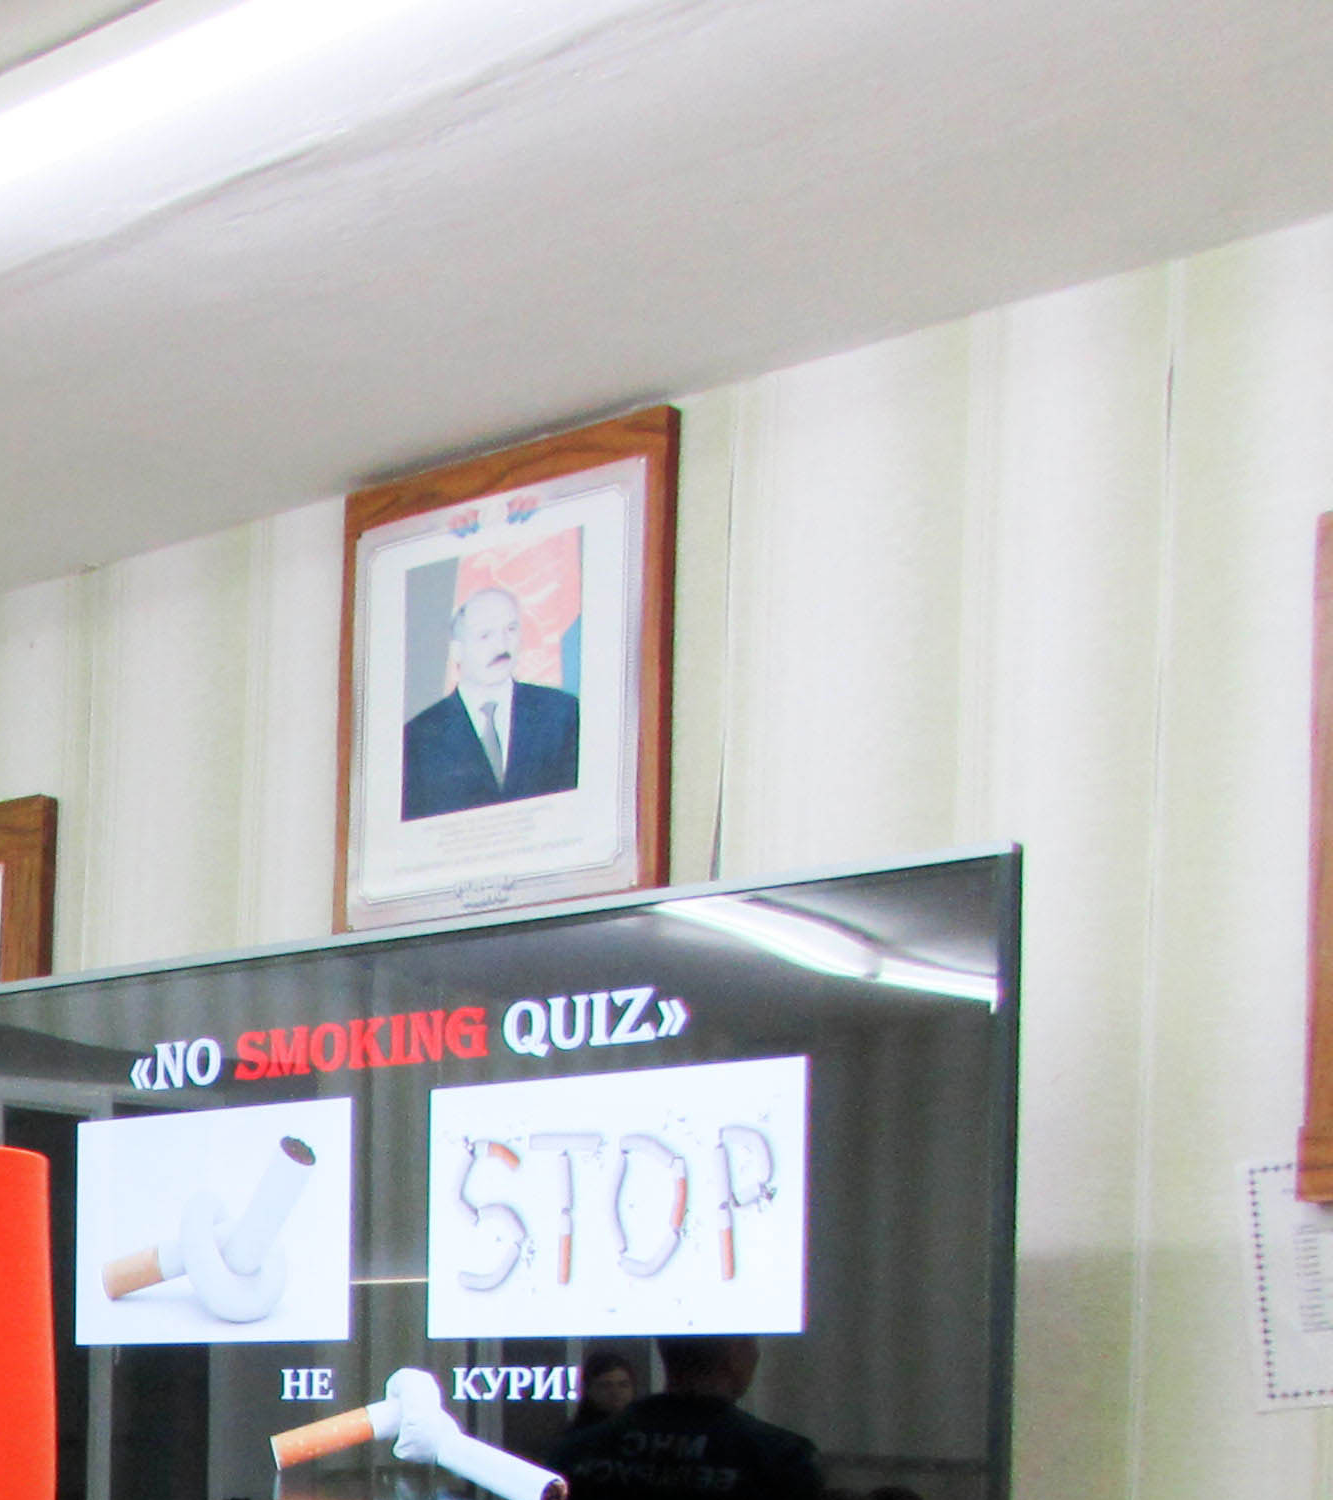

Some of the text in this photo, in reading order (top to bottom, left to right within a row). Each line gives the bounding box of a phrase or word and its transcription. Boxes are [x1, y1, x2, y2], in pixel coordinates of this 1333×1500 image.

[129, 984, 690, 1091] «NO SMOKING QUIZ»
[458, 1125, 776, 1292] STOP
[280, 1366, 579, 1401] НЕ КУРИ!
